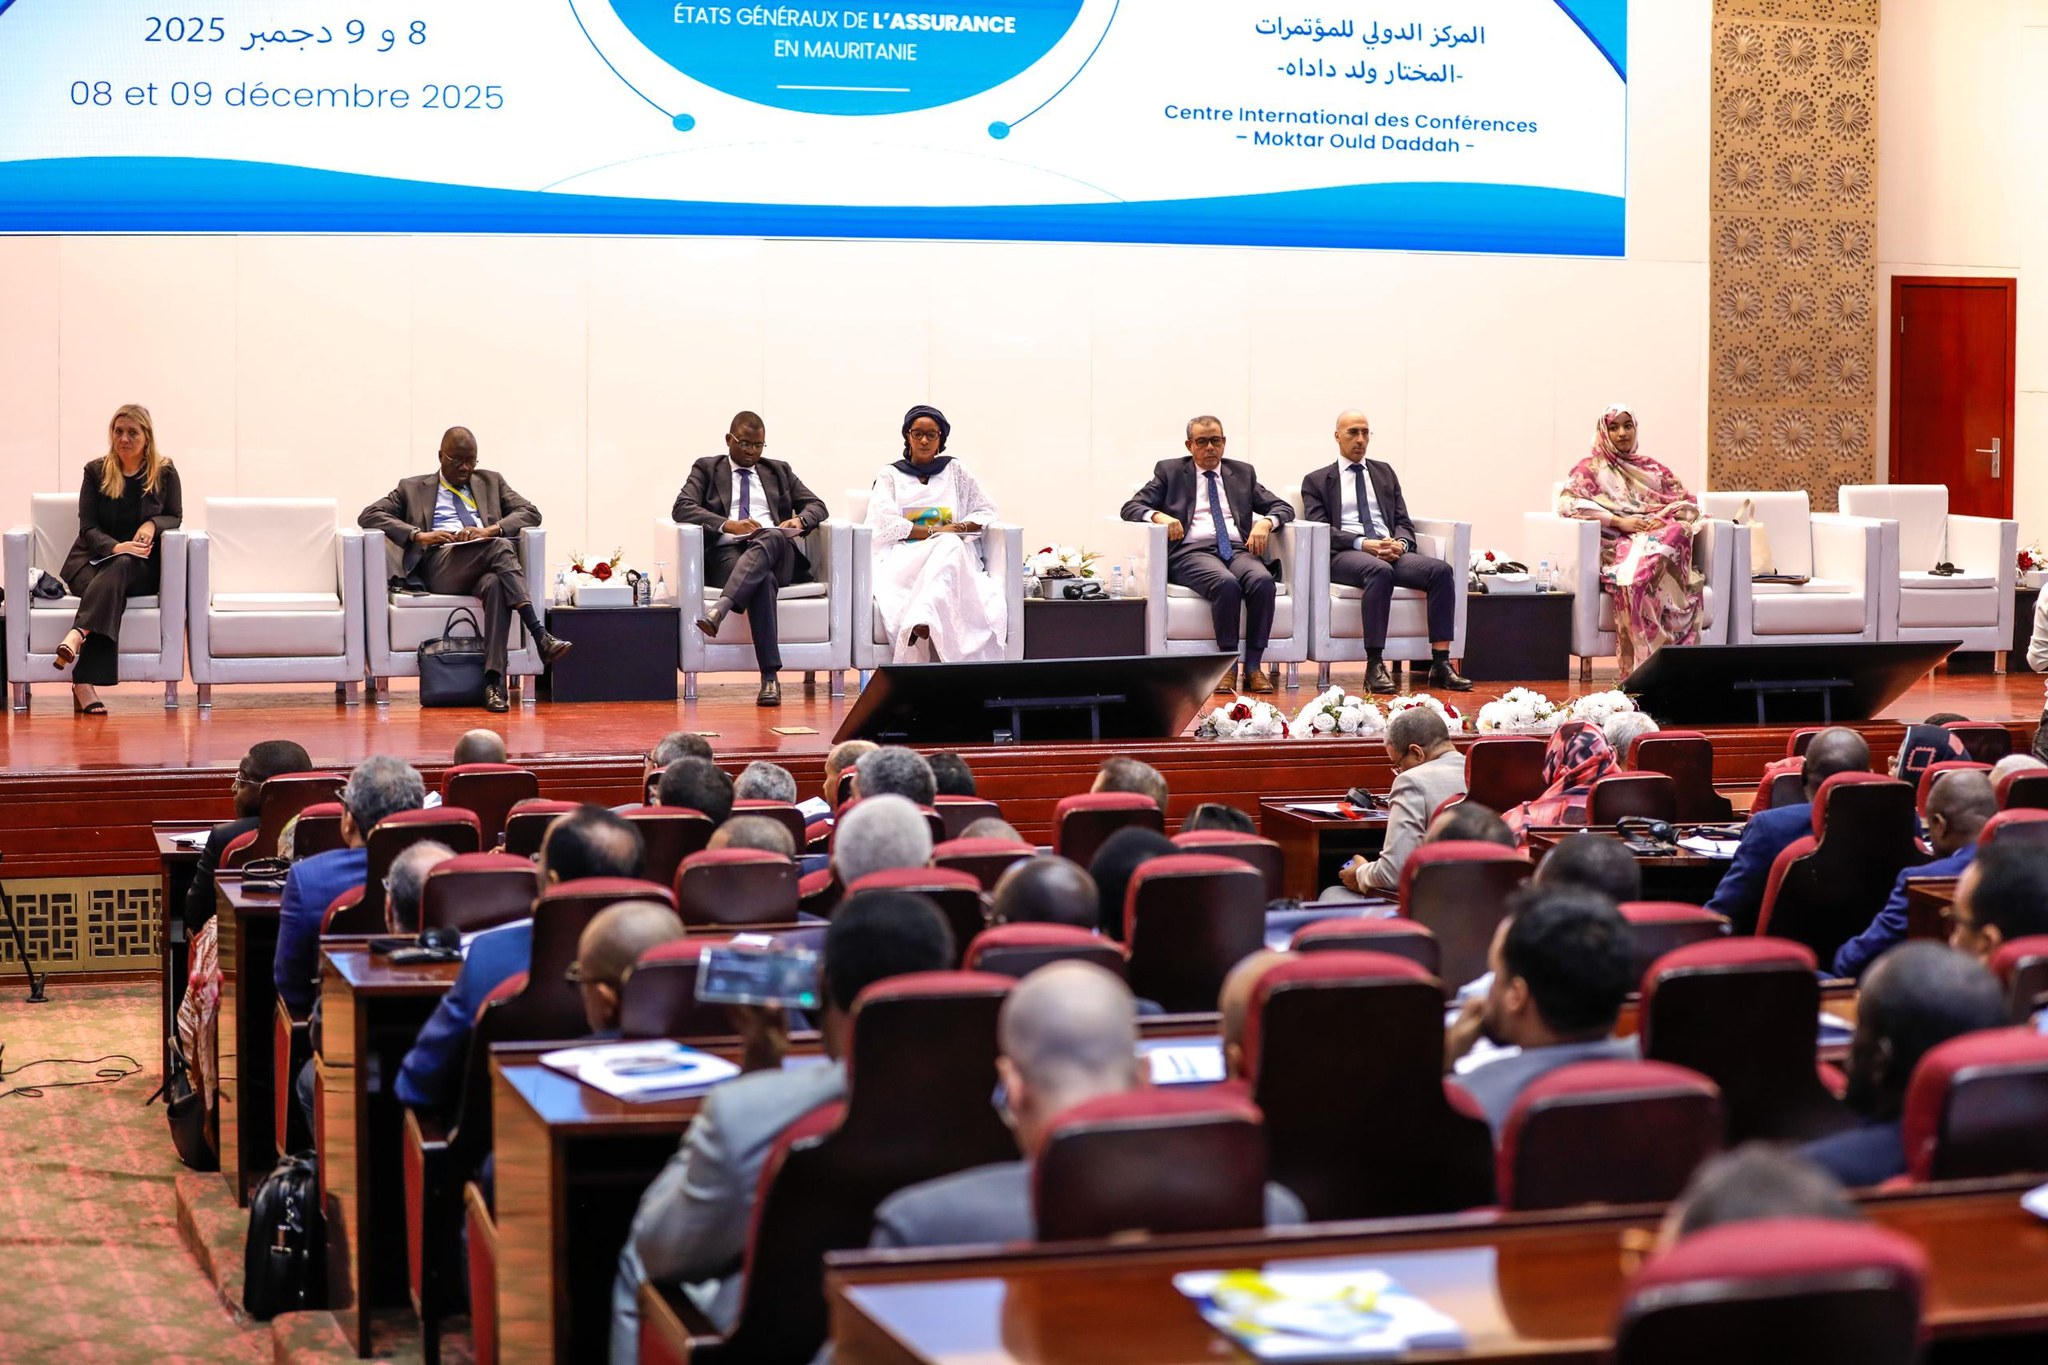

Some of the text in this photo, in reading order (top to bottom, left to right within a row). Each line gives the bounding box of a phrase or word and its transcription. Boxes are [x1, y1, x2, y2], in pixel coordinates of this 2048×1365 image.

[674, 2, 731, 26] ÉTATS
[736, 5, 838, 29] GÉNÉRAUX
[843, 11, 868, 30] DE
[1255, 16, 1354, 43] للمؤتمرات
[144, 16, 427, 53] 8 و 9 دجمبر 2025
[1429, 25, 1486, 49] المركز
[774, 39, 918, 62] EN MAURITANIE
[1344, 60, 1378, 85] ولد
[70, 80, 505, 110] 08 et 09 décembre 2025
[1164, 104, 1538, 134] Centre International des Conférences
[1254, 130, 1324, 148] Moktar
[1330, 134, 1376, 150] Ould
[1382, 136, 1460, 153] Daddah
